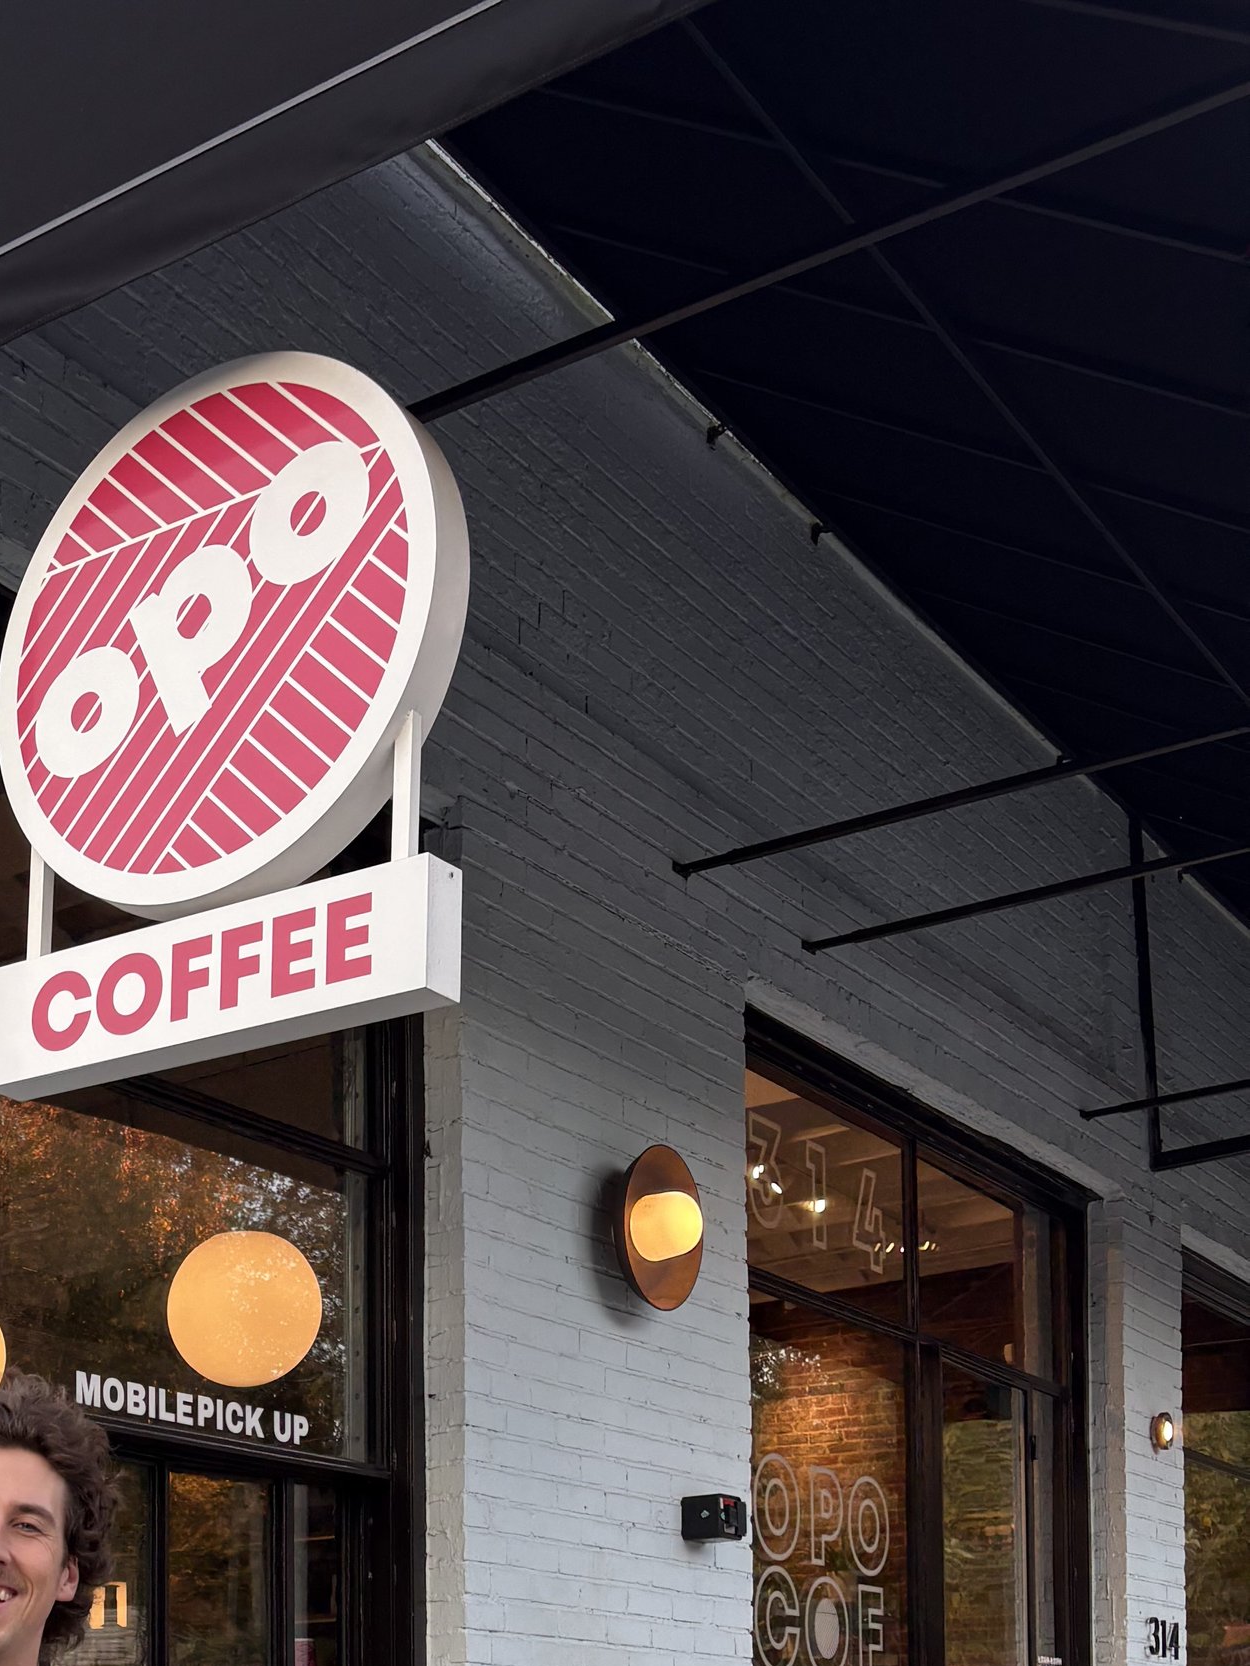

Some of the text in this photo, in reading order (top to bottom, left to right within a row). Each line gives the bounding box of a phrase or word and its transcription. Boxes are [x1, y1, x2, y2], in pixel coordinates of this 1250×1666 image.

[35, 440, 370, 778] opo
[31, 891, 373, 1052] COFFEE
[749, 1112, 886, 1275] 314
[273, 1410, 309, 1444] UP
[752, 1452, 890, 1577] OPO
[1146, 1616, 1180, 1660] 314
